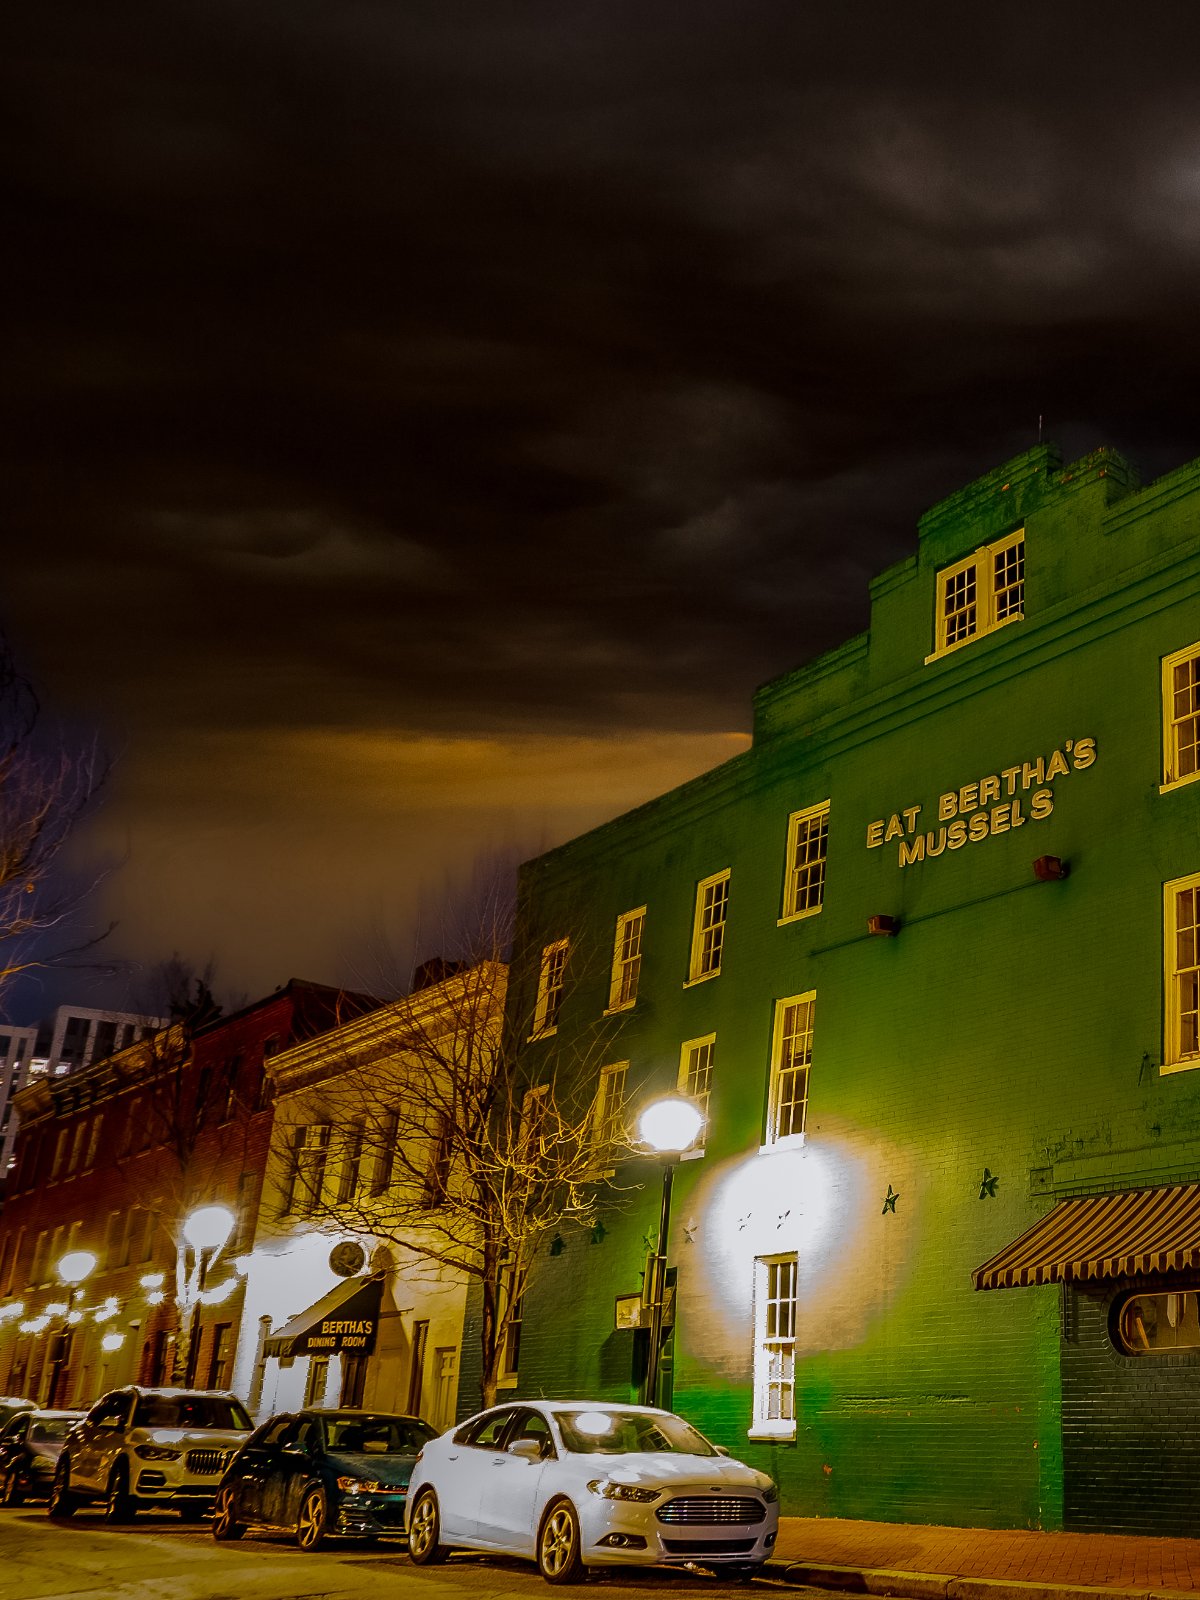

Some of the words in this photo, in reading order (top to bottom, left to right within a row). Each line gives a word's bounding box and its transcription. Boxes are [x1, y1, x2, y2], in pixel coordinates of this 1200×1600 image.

[866, 805, 922, 849] EAT
[938, 737, 1097, 822] BERTHA'S
[898, 788, 1055, 868] MUSSELS
[307, 1336, 337, 1348] DINING
[341, 1336, 367, 1348] ROOM
[321, 1320, 373, 1335] BERTHA'S
